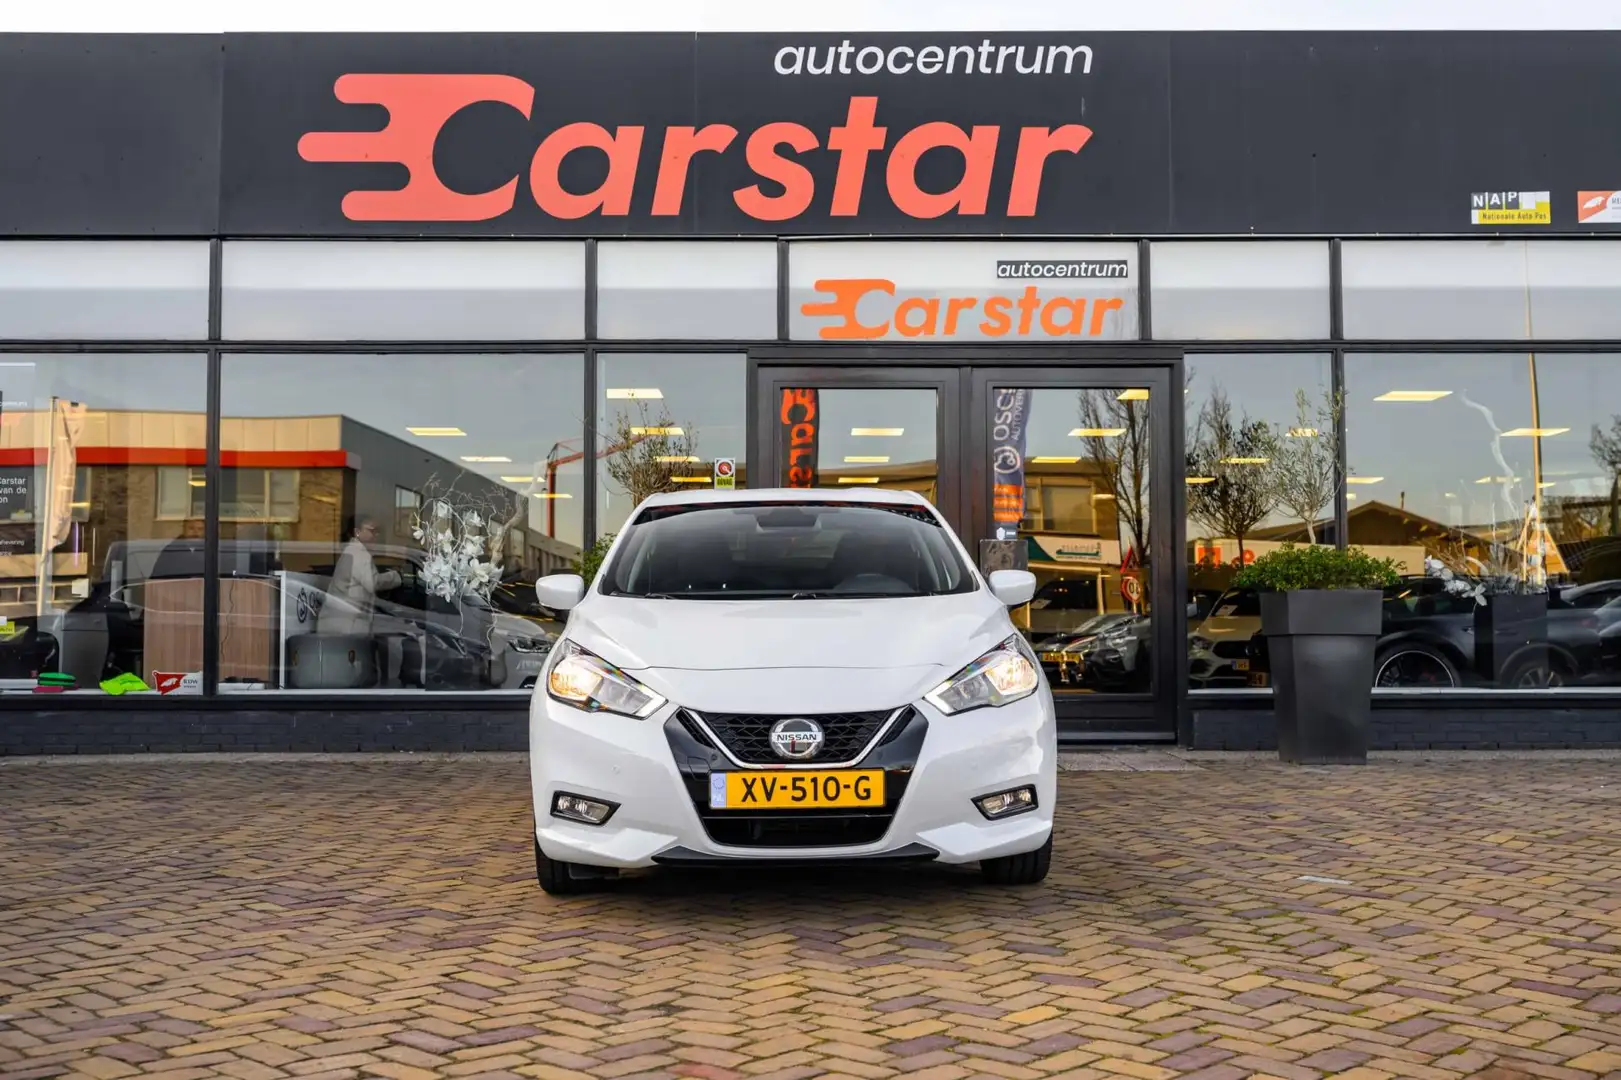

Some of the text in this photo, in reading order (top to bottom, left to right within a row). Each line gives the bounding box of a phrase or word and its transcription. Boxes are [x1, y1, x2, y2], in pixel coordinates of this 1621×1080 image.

[774, 40, 1093, 77] autocentrum
[297, 73, 1092, 221] Carstar
[1482, 212, 1547, 221] Nationale Auto Pas
[997, 261, 1128, 278] autocentrum
[801, 278, 1123, 341] Carstar
[16, 486, 27, 494] de
[776, 733, 817, 741] NISSAN
[741, 775, 872, 803] XV-510-G
